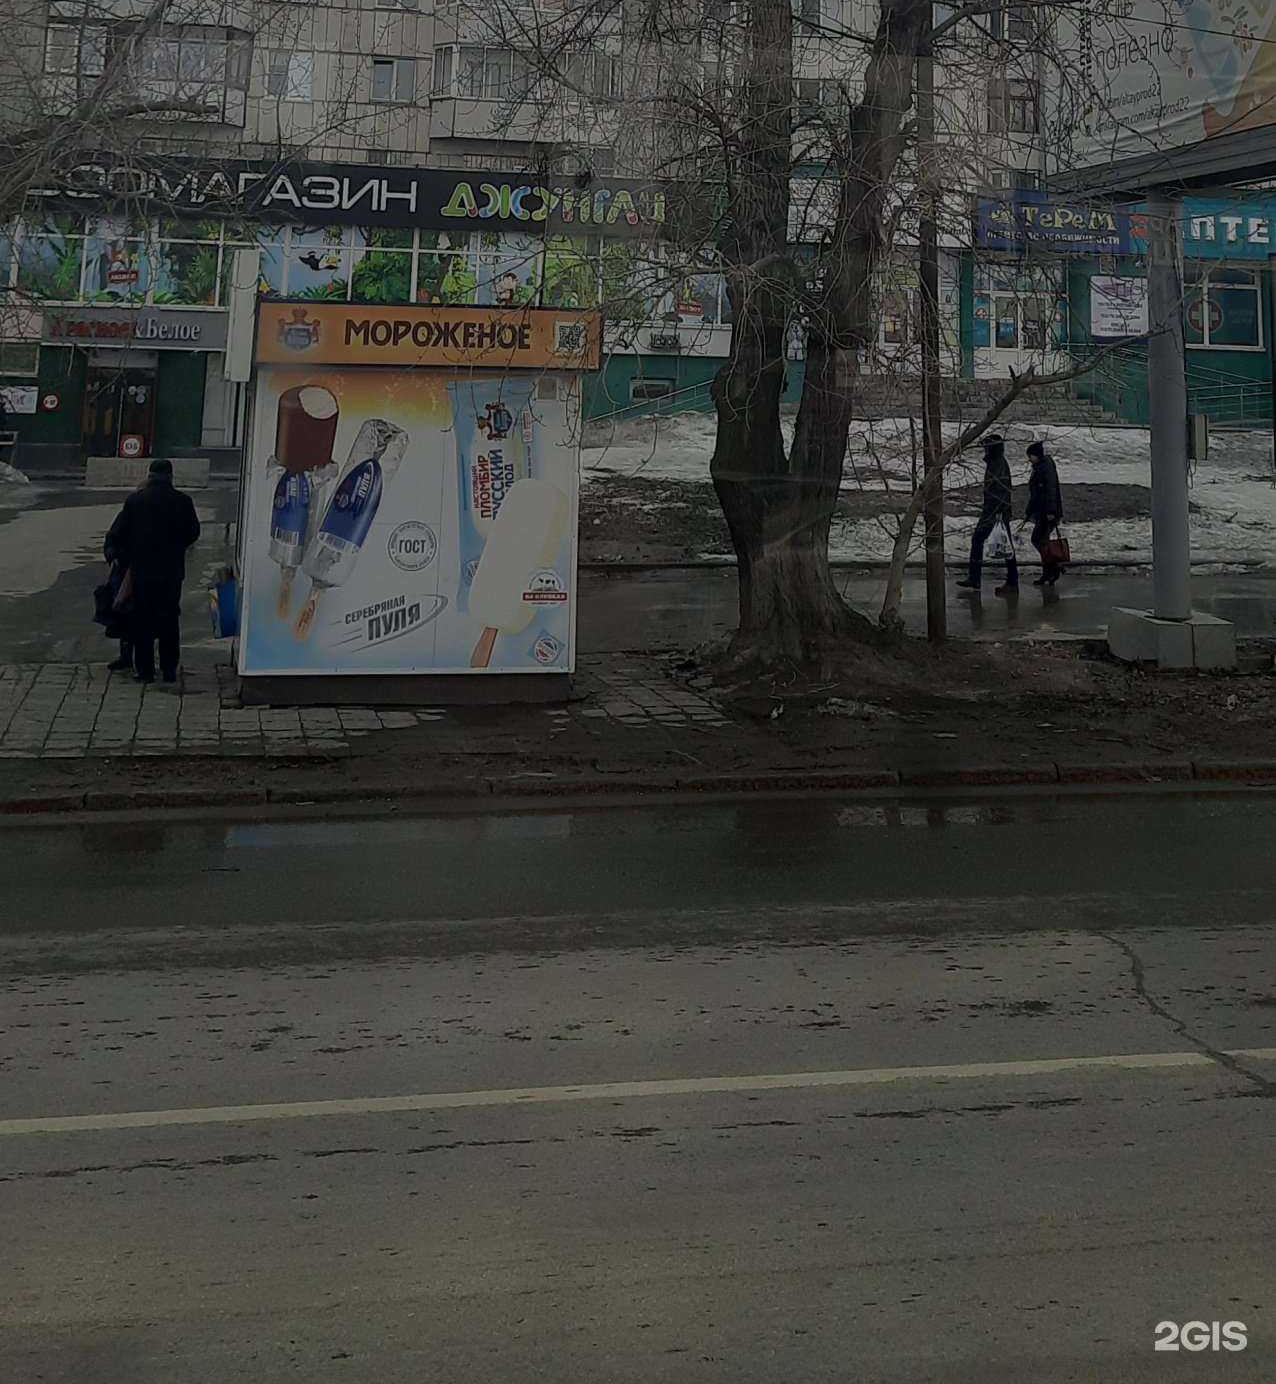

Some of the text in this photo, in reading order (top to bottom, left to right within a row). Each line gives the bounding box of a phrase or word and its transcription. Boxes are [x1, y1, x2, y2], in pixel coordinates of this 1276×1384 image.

[1180, 214, 1270, 244] ПТЕ
[344, 319, 531, 350] МОРОЖЕНОЕ
[478, 455, 492, 518] ПЛОМБИР
[399, 539, 427, 554] ГОСТ
[345, 595, 405, 624] СЕРЕБРЯНАЯ
[368, 602, 421, 640] ПУЛЯ
